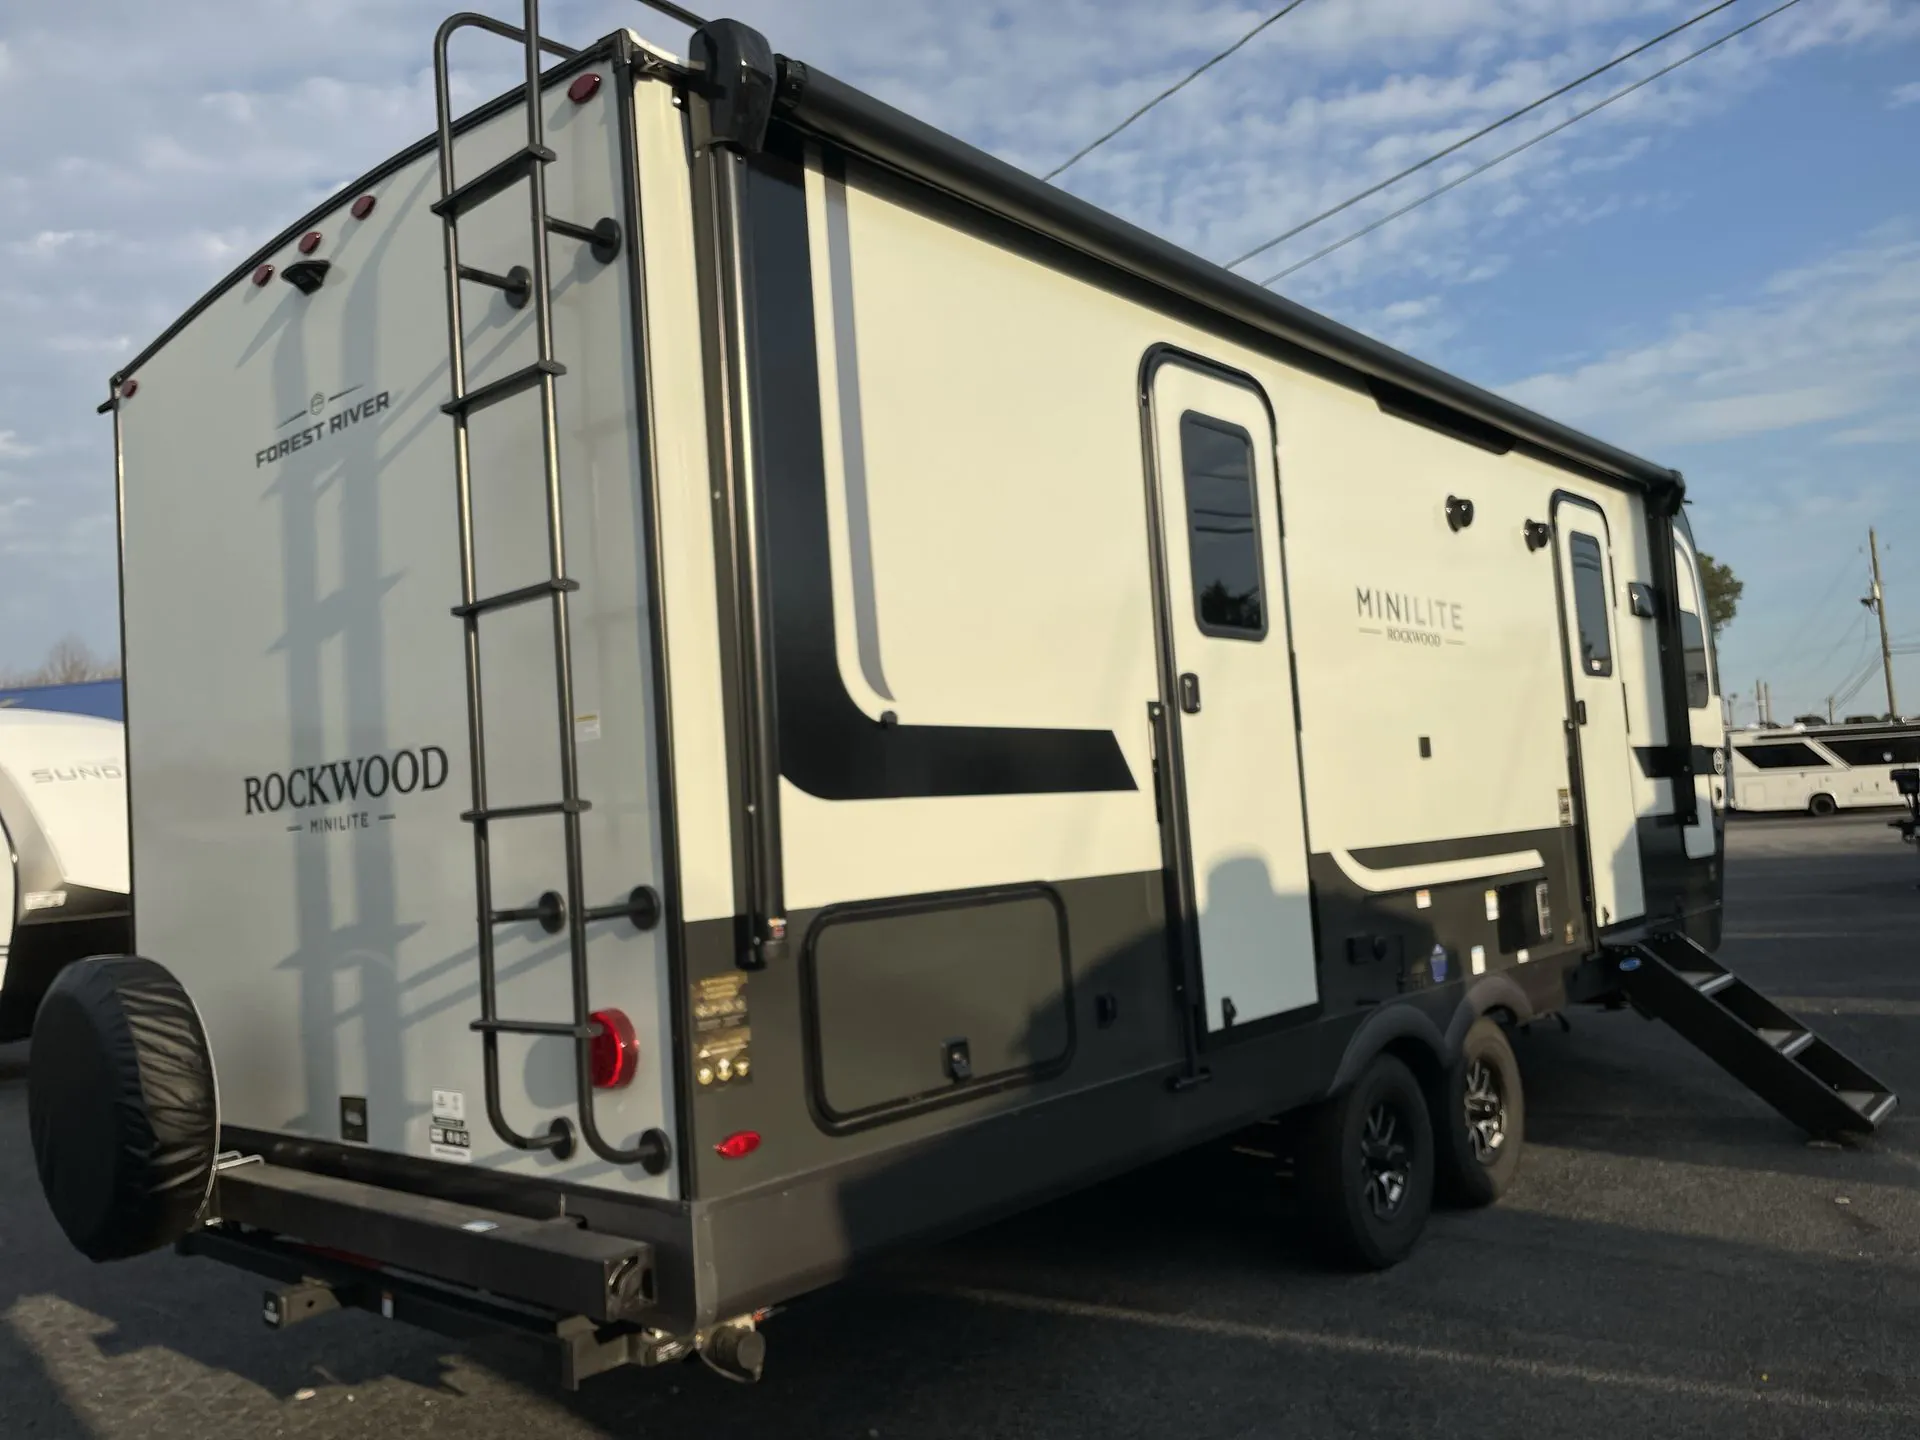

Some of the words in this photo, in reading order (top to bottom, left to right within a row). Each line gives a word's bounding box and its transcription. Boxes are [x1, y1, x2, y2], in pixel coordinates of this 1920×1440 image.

[255, 421, 325, 469] FOREST
[329, 391, 389, 434] RIVER
[1356, 586, 1463, 631] MINILITE
[1387, 628, 1441, 647] ROCKWOOD
[244, 746, 449, 815] ROCKWOOD
[310, 811, 370, 834] MINILITE
